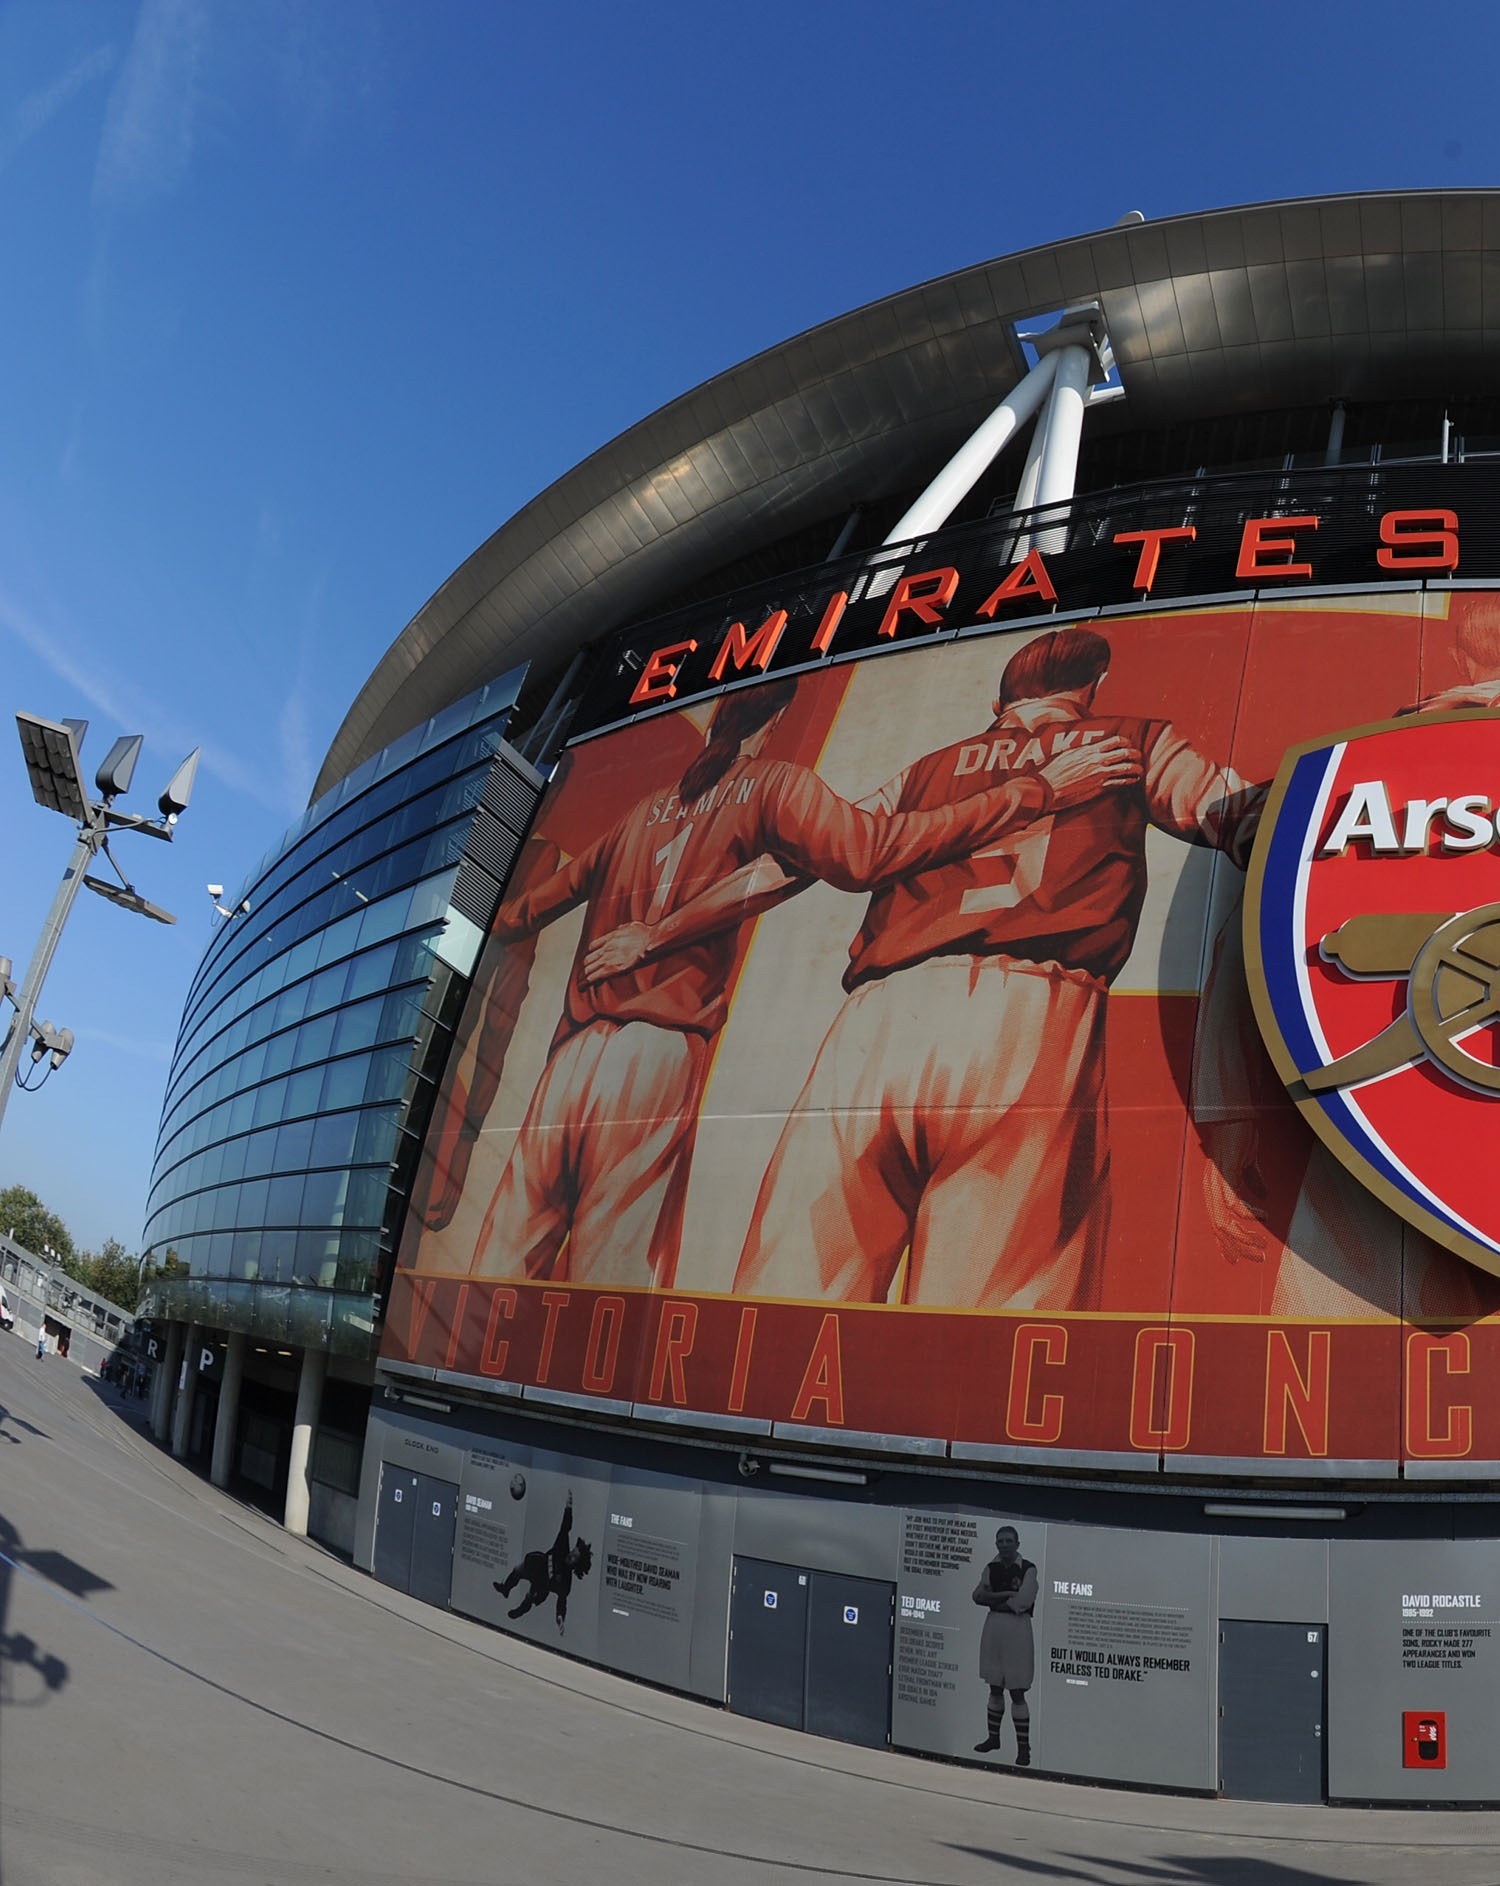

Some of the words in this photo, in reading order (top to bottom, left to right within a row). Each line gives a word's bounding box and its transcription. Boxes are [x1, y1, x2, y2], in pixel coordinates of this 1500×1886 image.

[629, 509, 1460, 705] EMIRATES
[147, 1338, 158, 1358] R
[407, 1279, 845, 1425] VICTORIA
[200, 1348, 214, 1372] P
[404, 1438, 424, 1449] CLOCK
[1053, 1581, 1069, 1594] THE
[1071, 1582, 1093, 1597] FANS
[901, 1595, 915, 1609] TED
[915, 1598, 941, 1613] DRAKE
[1402, 1595, 1430, 1607] DAVID
[1432, 1595, 1481, 1608] ROCASTLE
[1403, 1628, 1414, 1637] ONE
[1415, 1628, 1423, 1637] OF
[1425, 1628, 1436, 1637] THE
[1437, 1628, 1459, 1637] CLUB'S
[1460, 1628, 1492, 1637] FAVOURITE
[1422, 1639, 1442, 1647] ROCKY
[1461, 1639, 1474, 1647] 277
[1050, 1647, 1068, 1660] BUT
[1070, 1649, 1073, 1660] I
[1075, 1650, 1104, 1664] WOULD
[1106, 1653, 1141, 1668] ALWAYS
[1143, 1656, 1190, 1672] REMEMBER
[1462, 1650, 1475, 1658] WON
[1050, 1661, 1092, 1677] FEARLESS
[1095, 1666, 1110, 1679] TED
[1403, 1660, 1416, 1668] TWO
[1417, 1660, 1441, 1668] LEAGUE
